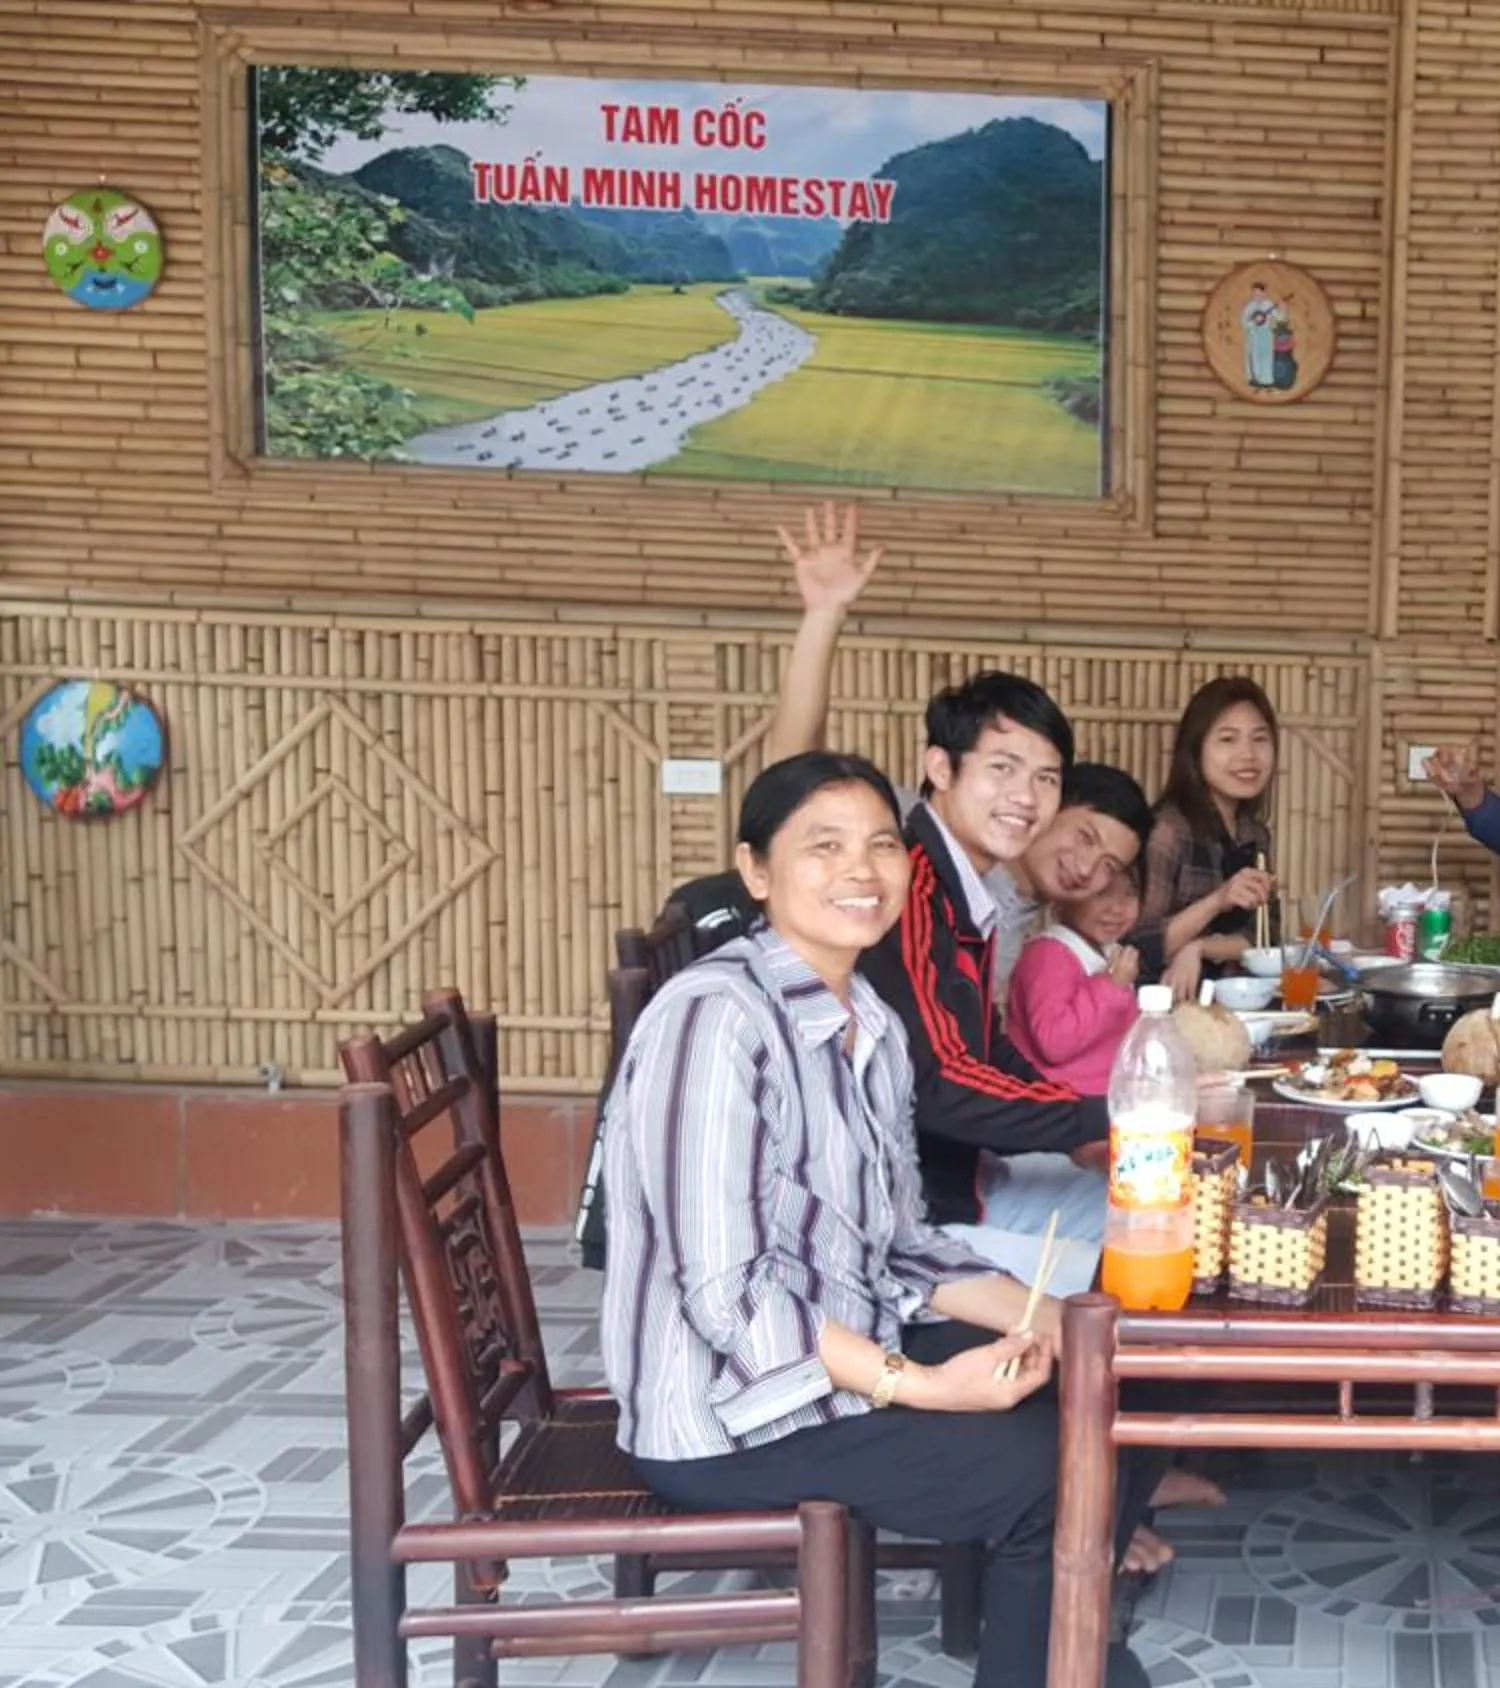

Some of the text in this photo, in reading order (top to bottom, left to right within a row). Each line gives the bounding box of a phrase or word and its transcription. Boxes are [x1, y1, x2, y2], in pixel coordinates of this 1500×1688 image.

[601, 97, 767, 149] TAM CỐC
[472, 150, 897, 221] TUẤN MINH HOMESTAY
